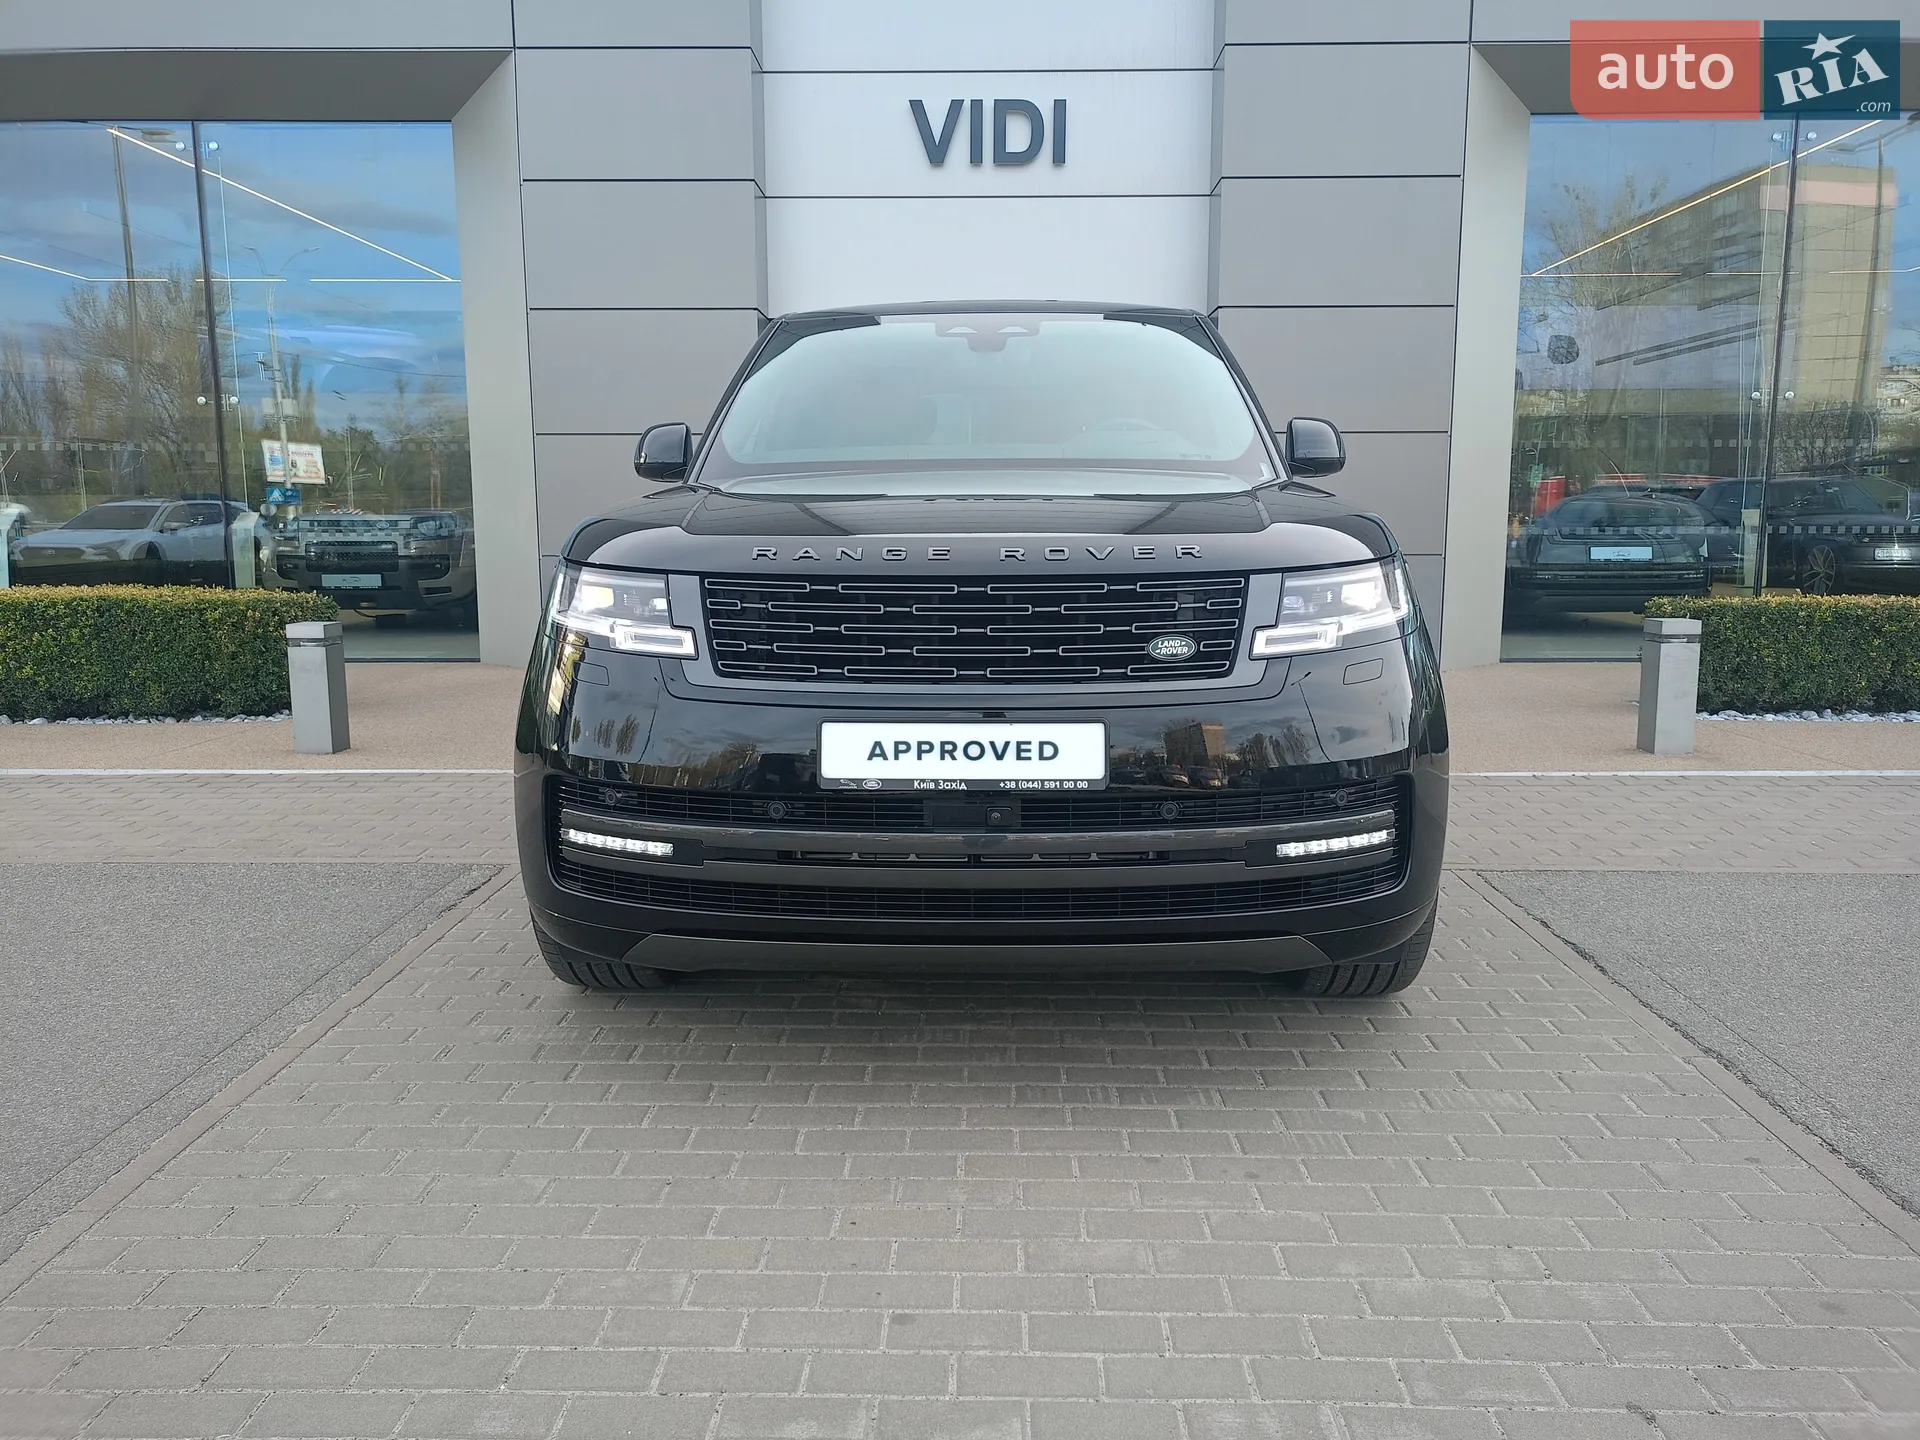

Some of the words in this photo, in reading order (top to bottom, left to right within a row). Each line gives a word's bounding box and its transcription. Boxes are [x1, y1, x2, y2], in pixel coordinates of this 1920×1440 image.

[908, 99, 1067, 164] VIDI
[752, 546, 950, 561] RANGE
[1000, 544, 1202, 561] ROVER
[1158, 640, 1180, 648] LAND
[1160, 646, 1188, 655] ROVER
[867, 740, 1060, 762] APPROVED
[913, 779, 935, 790] Київ
[938, 780, 967, 790] Захід
[999, 781, 1016, 789] +38
[1018, 780, 1041, 790] (044)
[1044, 781, 1060, 789] 591
[1063, 781, 1075, 789] 00
[1076, 781, 1088, 789] 00
